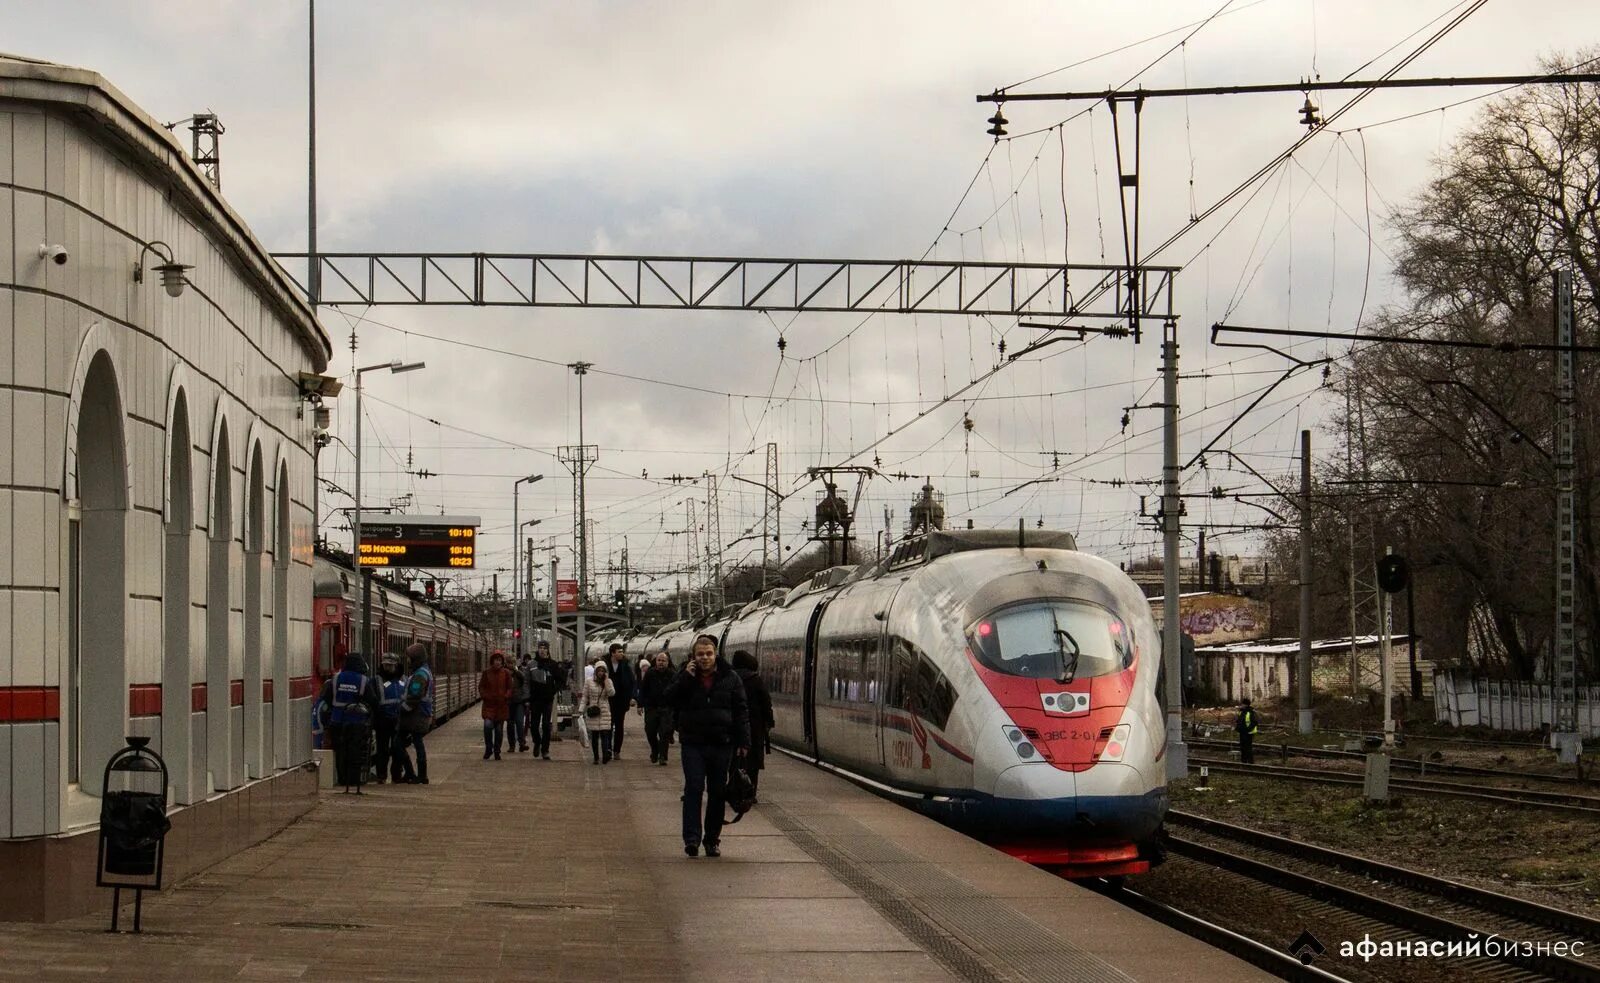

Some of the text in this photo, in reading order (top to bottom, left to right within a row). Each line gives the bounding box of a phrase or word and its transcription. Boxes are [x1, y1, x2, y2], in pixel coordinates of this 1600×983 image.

[394, 526, 403, 538] 3
[449, 528, 473, 537] 10:10
[373, 544, 406, 553] Москва
[450, 546, 473, 554] 10:10
[450, 557, 472, 566] 10:23
[1044, 730, 1096, 741] ЭВС 2-01
